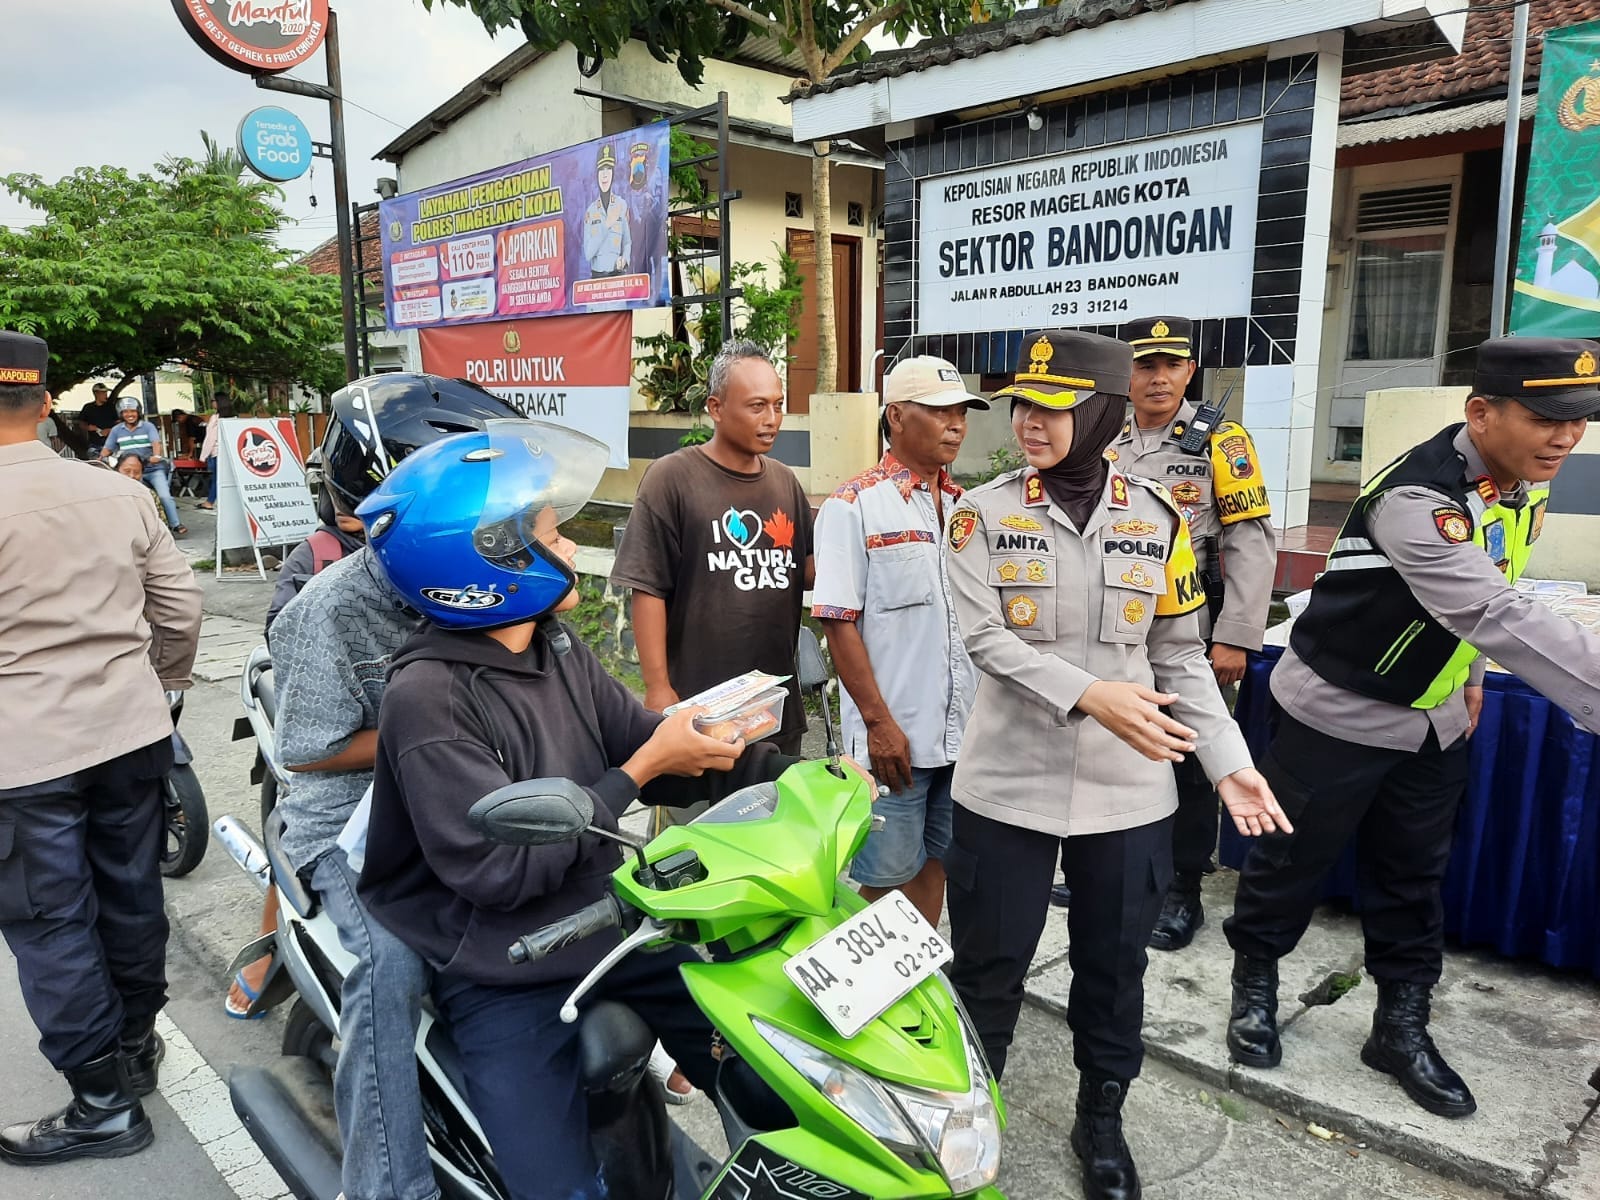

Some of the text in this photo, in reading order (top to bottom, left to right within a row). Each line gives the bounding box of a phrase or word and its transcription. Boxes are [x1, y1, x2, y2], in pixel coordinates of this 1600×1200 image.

[231, 0, 308, 22] Mantul
[190, 0, 322, 63] THE BEST GEPREK & FRIED CHICKEN
[282, 24, 303, 33] 2020
[256, 121, 288, 131] Tersedia
[257, 130, 298, 147] Grab
[257, 146, 300, 164] Food
[944, 138, 1229, 203] KEPOLISIAN NEGARA REPUBLIK INDONESIA
[420, 166, 550, 219] LAYANAN PENGADUAN
[972, 177, 1191, 226] RESOR MAGELANG KOTA
[412, 190, 562, 242] POLRES MAGELANG KOTA
[501, 226, 558, 266] LAPORKAN
[939, 205, 1233, 278] SEKTOR BANDONGAN
[452, 251, 474, 272] 110
[950, 271, 1180, 303] JALAN R ABDULLAH 23 BANDONGAN
[1051, 299, 1128, 316] 293 31214
[0, 370, 38, 381] KAPOLRES
[465, 356, 566, 383] POLRI UNTUK
[496, 392, 566, 416] ARAKAT
[1166, 464, 1207, 476] POLRI
[244, 483, 268, 491] BESAR
[711, 519, 721, 543] I
[996, 534, 1050, 553] ANITA
[1104, 540, 1164, 560] POLRI
[734, 568, 790, 591] GAS
[795, 956, 839, 998] AA
[836, 914, 897, 965] 3894
